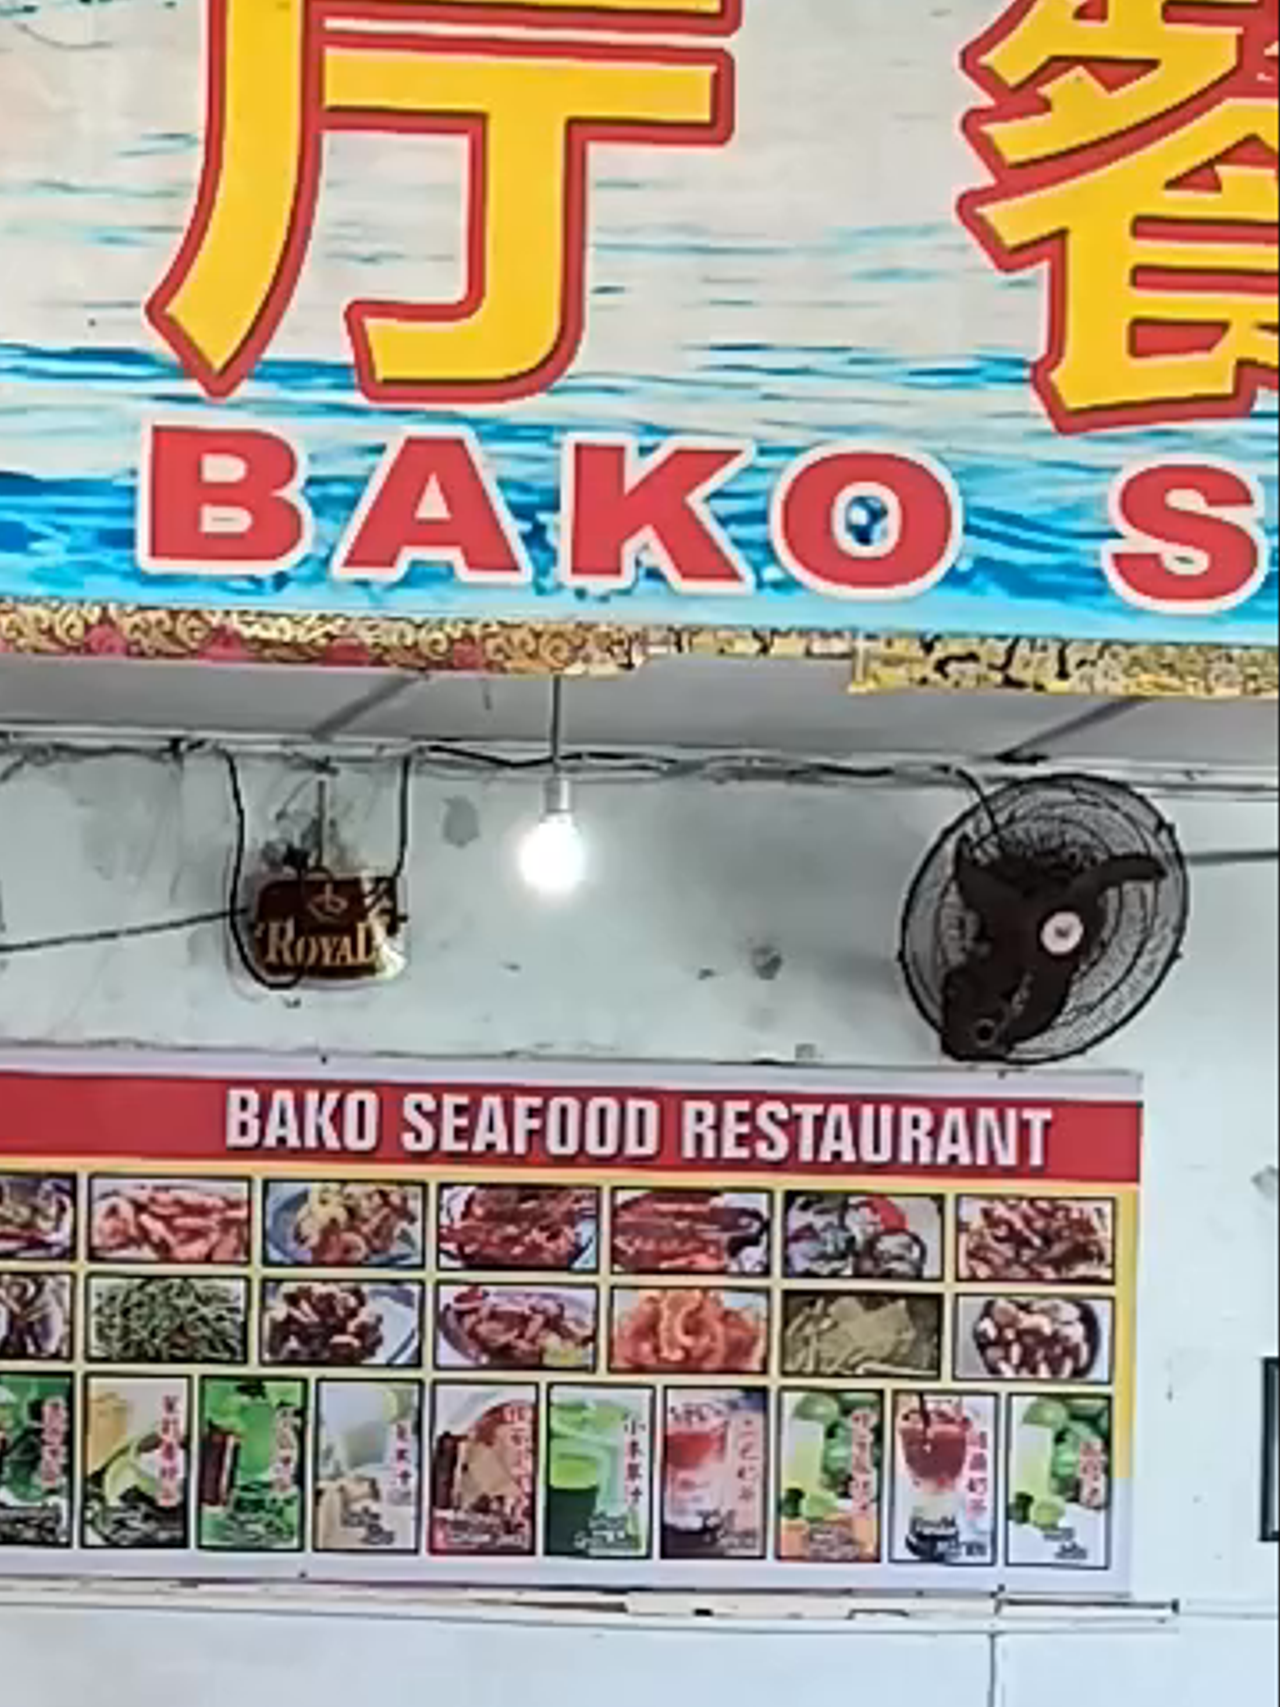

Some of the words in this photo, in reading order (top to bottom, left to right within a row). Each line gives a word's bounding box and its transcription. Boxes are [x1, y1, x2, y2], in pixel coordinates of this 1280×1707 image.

[147, 424, 954, 592] BAKO
[225, 1089, 380, 1152] BAKO
[400, 1093, 659, 1161] SEAFOOD
[681, 1105, 1053, 1168] RESTAURANT
